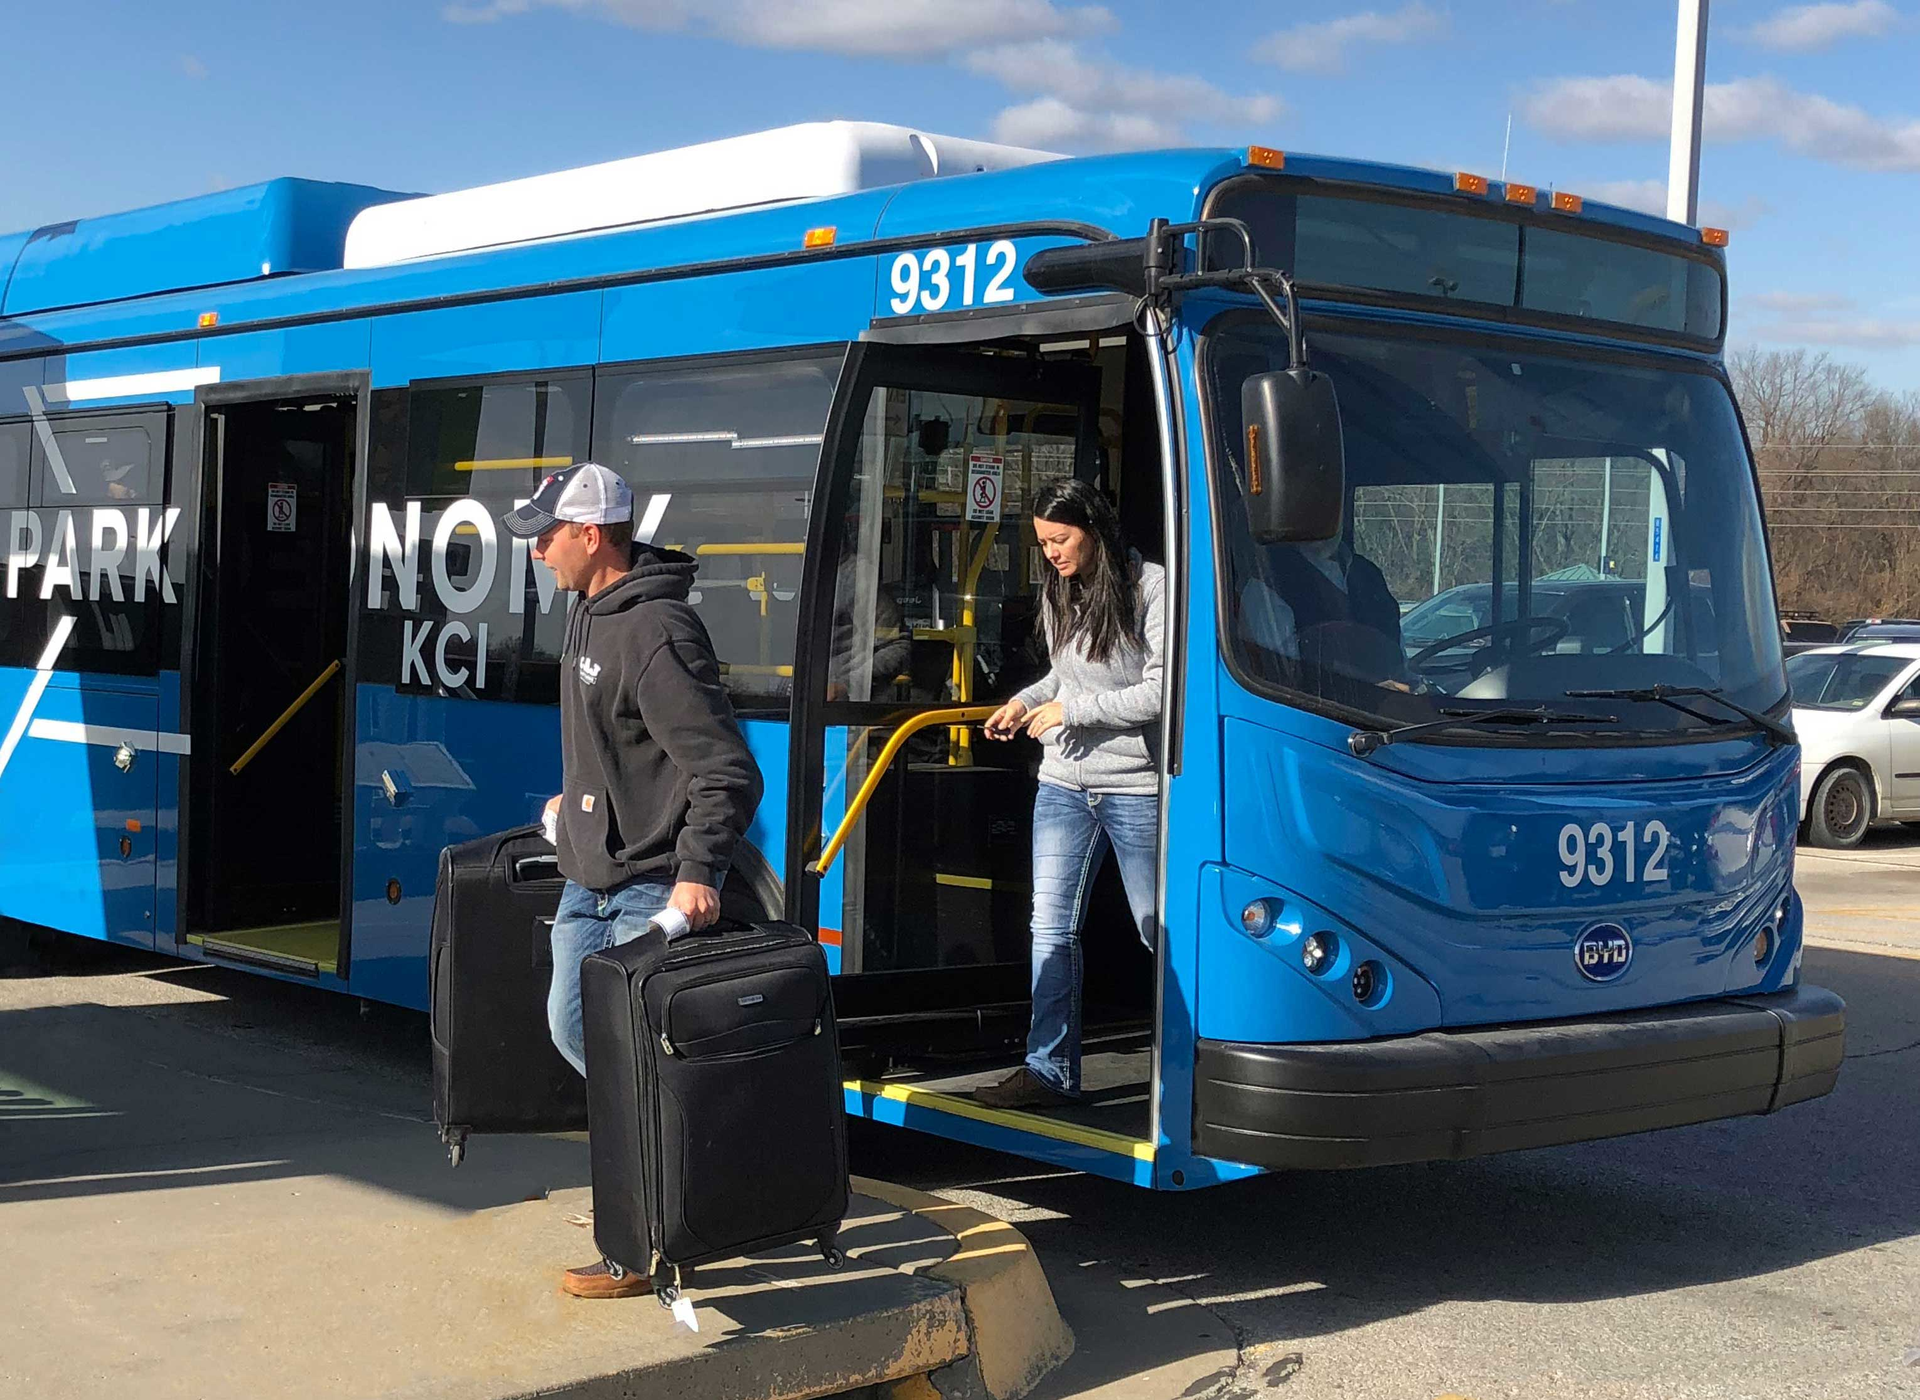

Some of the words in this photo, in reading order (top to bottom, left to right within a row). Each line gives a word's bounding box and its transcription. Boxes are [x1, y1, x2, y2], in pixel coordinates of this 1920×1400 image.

[889, 239, 1017, 315] 9312
[6, 507, 182, 604] PARK
[401, 620, 489, 689] KCI
[1558, 819, 1669, 888] 9312
[1583, 939, 1627, 965] BYD
